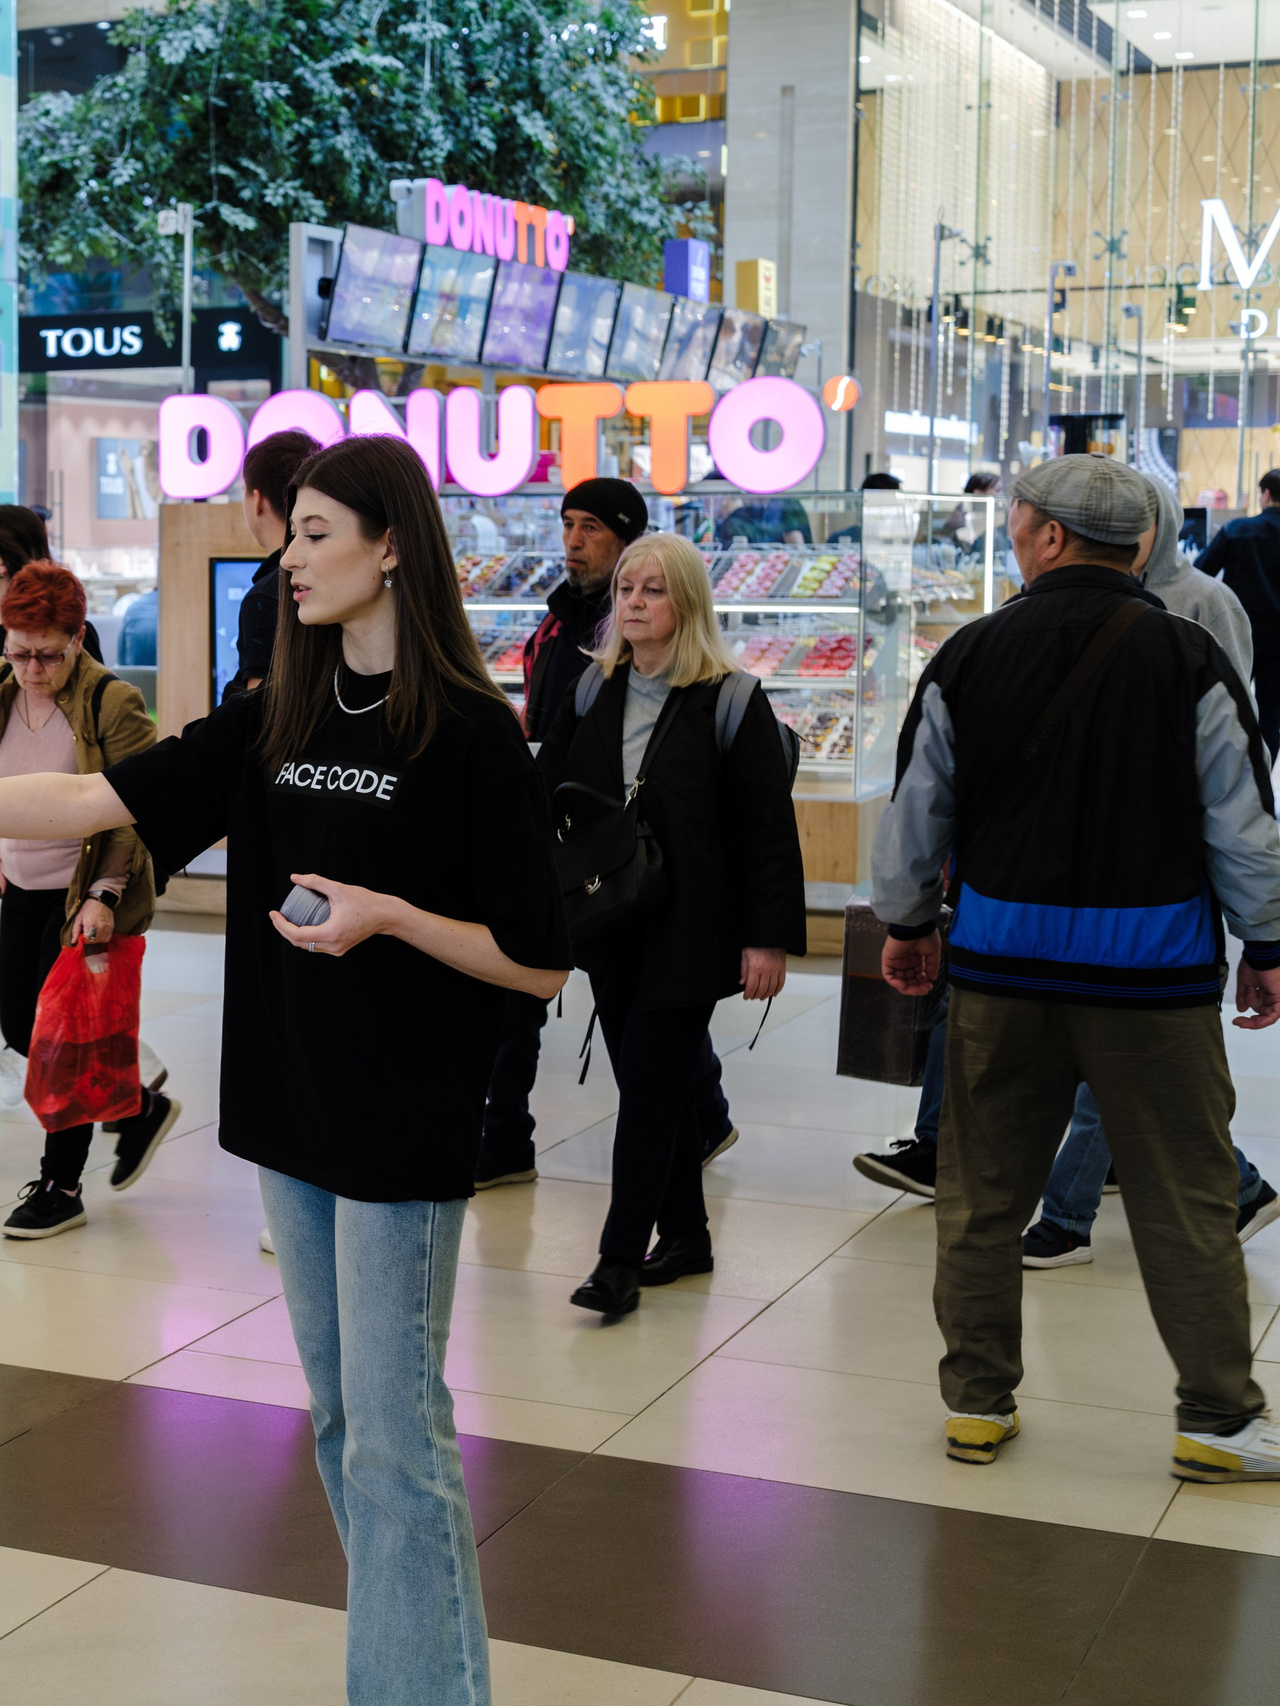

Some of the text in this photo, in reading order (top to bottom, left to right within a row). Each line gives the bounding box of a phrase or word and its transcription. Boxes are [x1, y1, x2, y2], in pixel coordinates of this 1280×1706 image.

[424, 177, 570, 273] DONUTTO
[39, 325, 144, 358] TOUS
[99, 476, 125, 495] TOUS
[275, 761, 398, 801] FACE CODE
